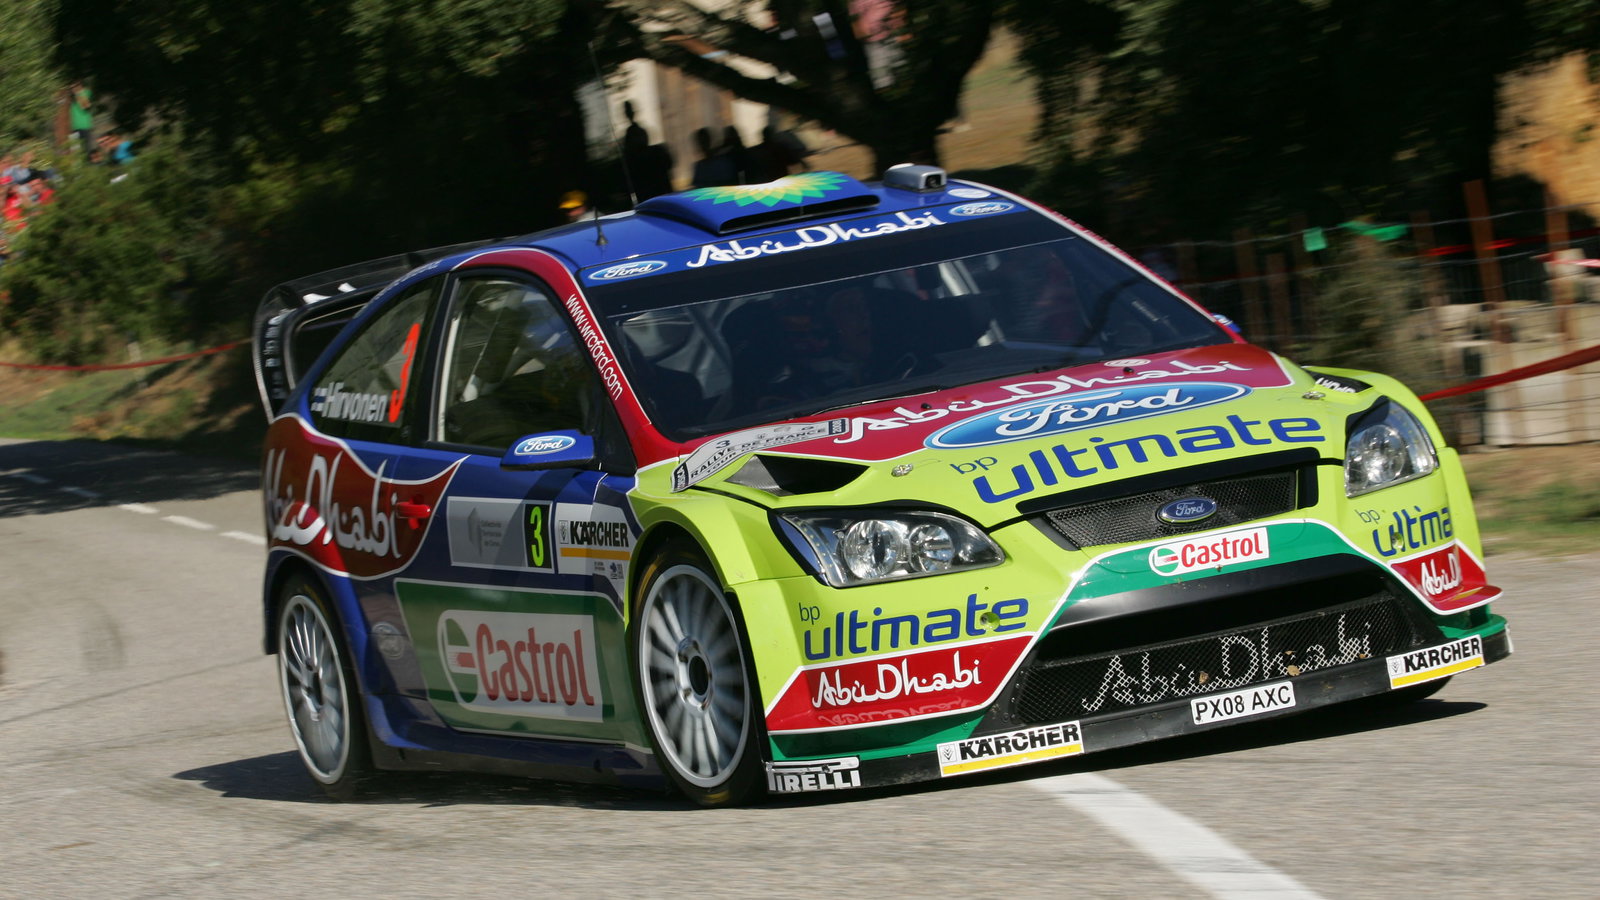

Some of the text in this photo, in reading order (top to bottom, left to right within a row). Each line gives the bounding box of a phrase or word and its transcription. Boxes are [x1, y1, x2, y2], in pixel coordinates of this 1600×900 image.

[604, 263, 653, 278] Ford
[566, 294, 623, 400] www.wrcford.com
[389, 323, 421, 423] 3
[322, 381, 387, 422] Hirvonen
[995, 388, 1198, 440] Ford
[524, 437, 563, 452] Ford
[972, 414, 1326, 504] ultimate
[690, 448, 735, 478] RALLYE
[950, 455, 998, 475] bp
[1175, 501, 1205, 516] Ford
[1355, 509, 1381, 524] bp
[530, 506, 544, 567] 3
[569, 520, 629, 547] KÄRCHER
[1181, 532, 1263, 568] Castrol
[799, 602, 820, 624] bp
[804, 593, 1029, 661] ultimate
[476, 622, 594, 706] Castrol
[1403, 637, 1480, 673] KÄRCHER
[1195, 685, 1291, 721] PX08 AXC
[958, 723, 1080, 761] KÄRCHER
[766, 757, 861, 792] PIRELLI
